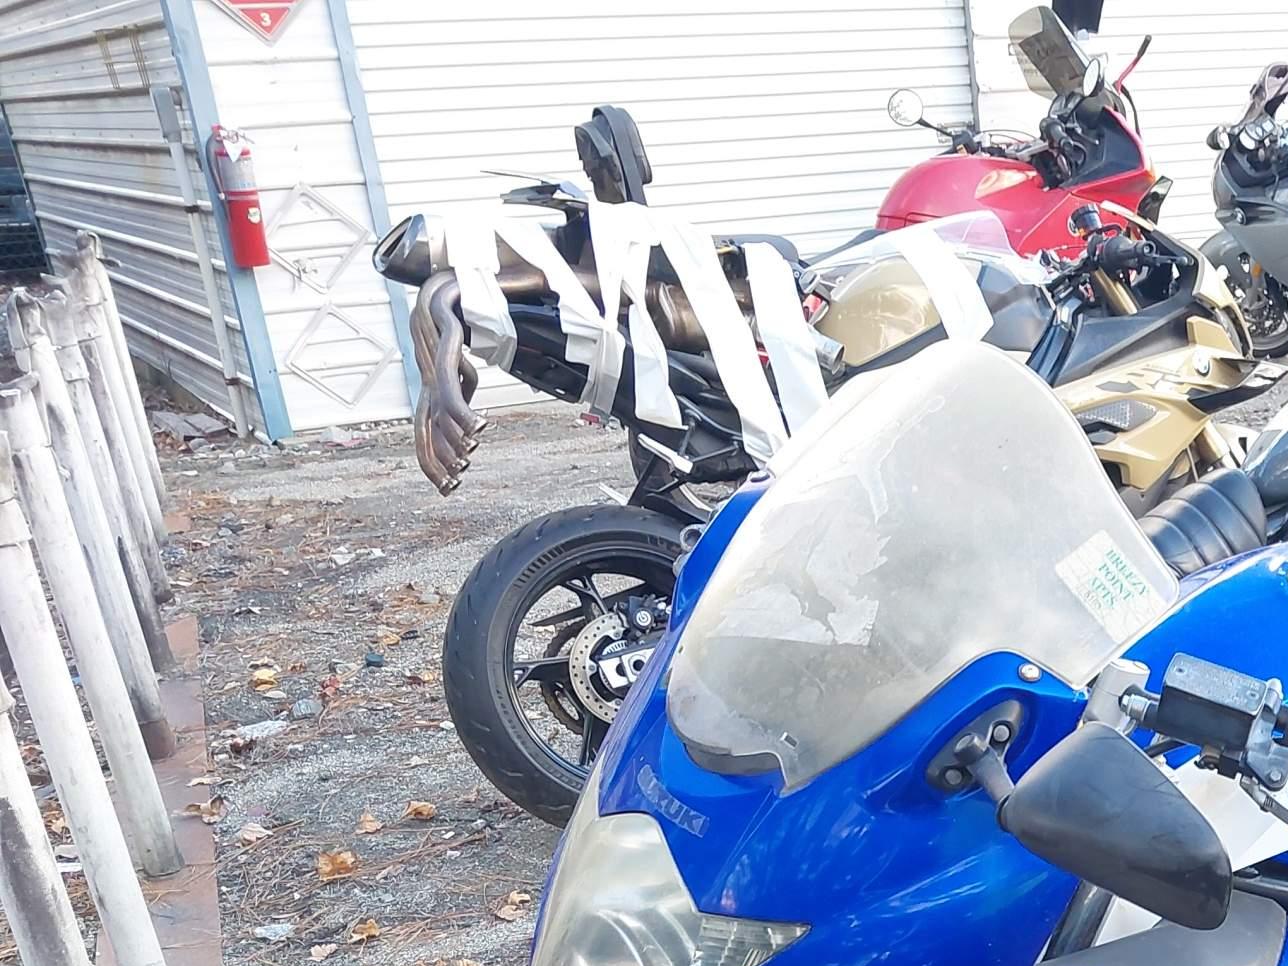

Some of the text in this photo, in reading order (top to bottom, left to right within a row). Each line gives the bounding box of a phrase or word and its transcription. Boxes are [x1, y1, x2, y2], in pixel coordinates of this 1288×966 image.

[260, 12, 272, 27] 3
[1098, 563, 1133, 600] POINT
[1106, 549, 1147, 595] BREEZY
